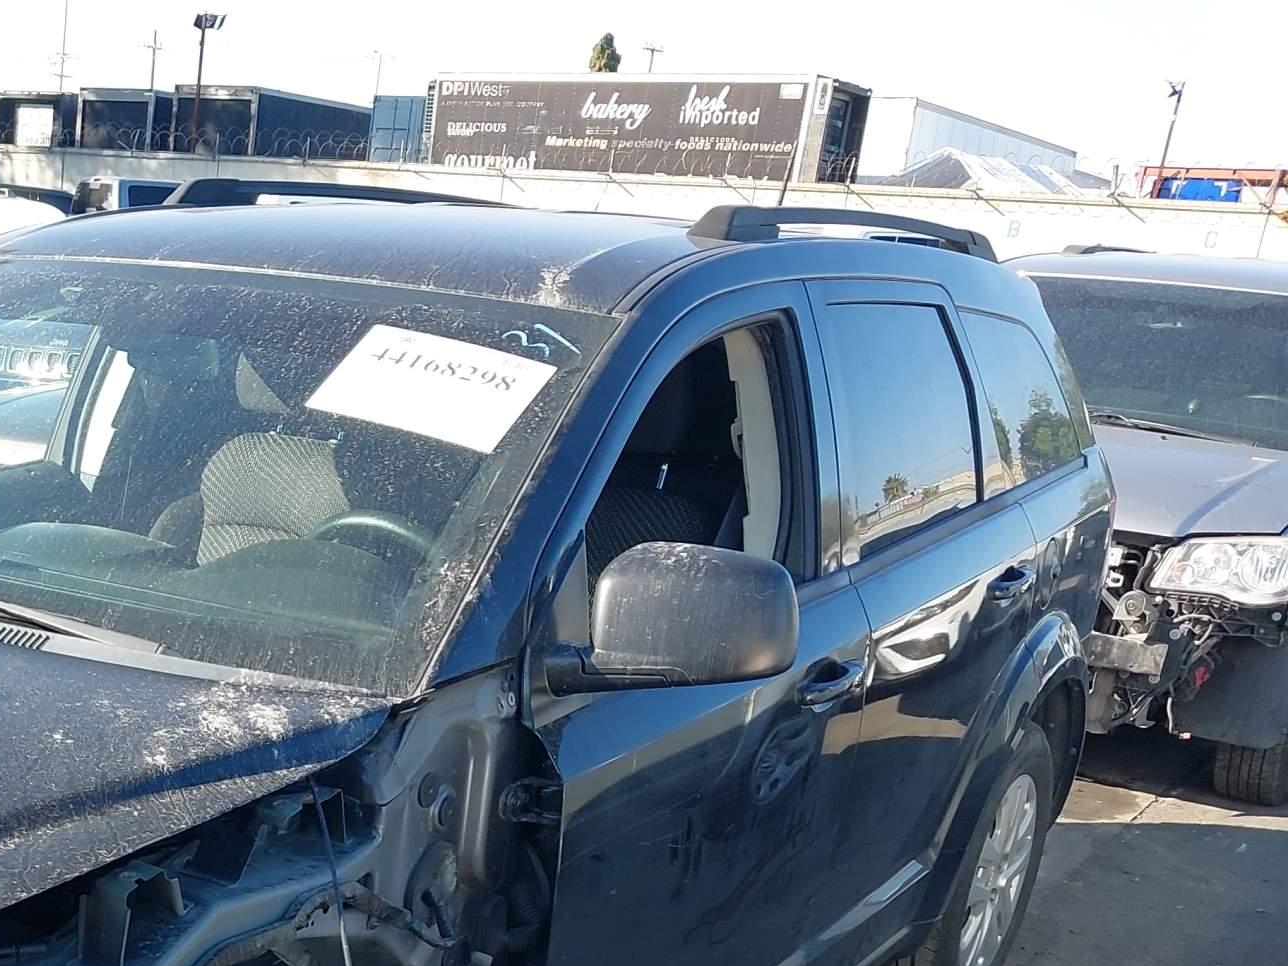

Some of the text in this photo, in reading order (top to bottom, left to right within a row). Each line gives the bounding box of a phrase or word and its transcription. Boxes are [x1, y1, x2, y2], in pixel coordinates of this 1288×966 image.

[580, 91, 652, 130] bakery
[679, 106, 760, 127] imported
[447, 121, 507, 133] DELICIOUS
[544, 135, 609, 150] Marketing
[1007, 220, 1021, 238] B
[1204, 230, 1218, 249] C
[370, 347, 517, 391] 44168298
